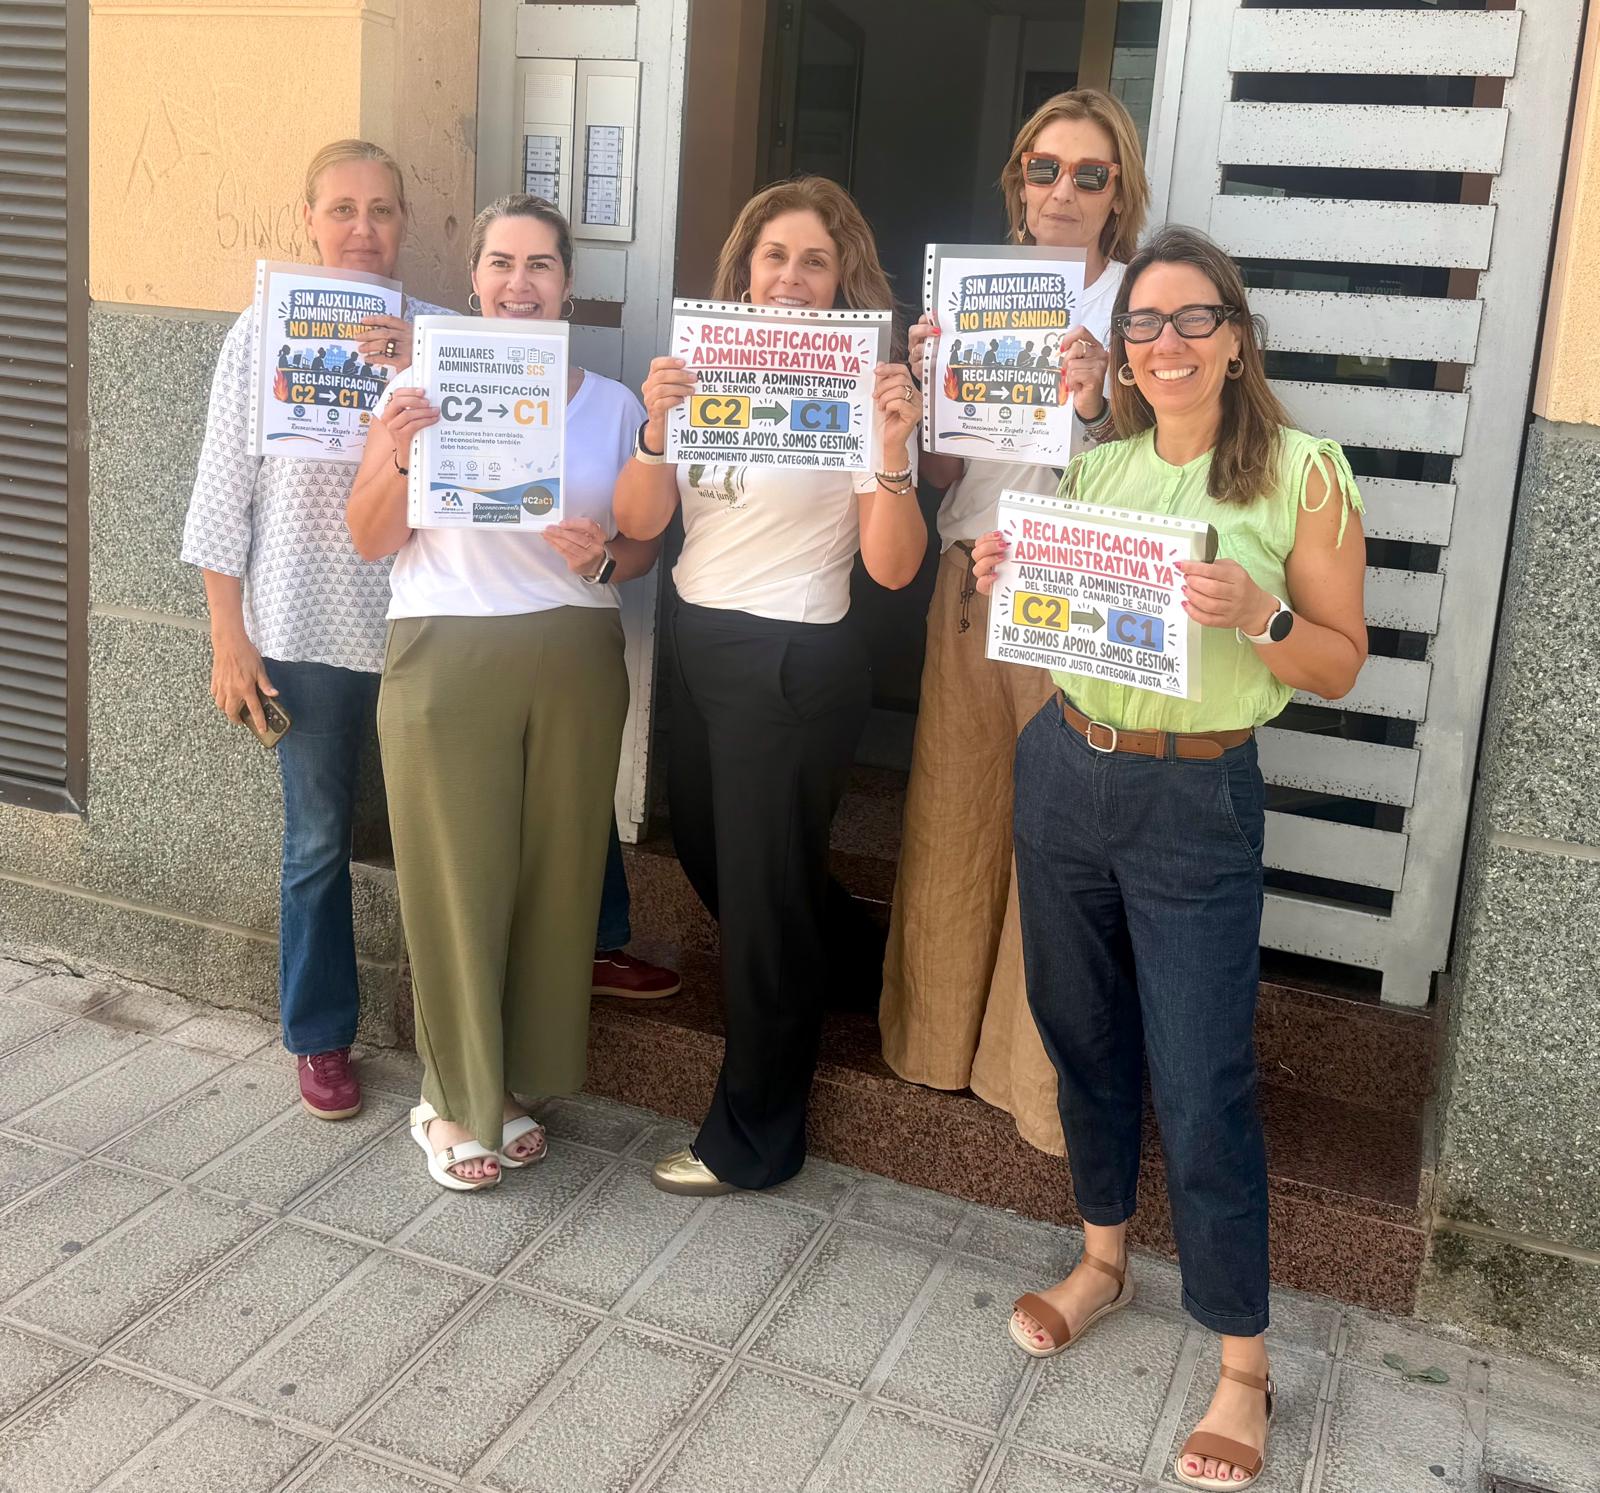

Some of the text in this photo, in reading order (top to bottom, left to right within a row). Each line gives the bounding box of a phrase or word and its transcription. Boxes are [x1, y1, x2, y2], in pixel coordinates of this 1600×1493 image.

[965, 276, 1062, 295] SIN AUXILIARES
[294, 292, 384, 311] SIN AUXILIARES
[963, 293, 1064, 311] ADMINISTRATIVOS
[289, 321, 308, 337] NO
[312, 322, 335, 338] HAY
[960, 310, 1066, 330] NO HAY SANIDAD
[701, 324, 853, 353] RECLASIFICACIÓN
[438, 346, 495, 360] AUXILIARES
[691, 347, 861, 374] ADMINISTRATIVA YA
[438, 360, 545, 377] ADMINISTRATIVOS SCS
[962, 369, 1056, 386] RECLASIFICACIÓN
[292, 372, 378, 393] RECLASIFICACIÓN
[439, 382, 550, 397] RECLASIFICACIÓN
[696, 370, 857, 391] AUXILIAR ADMINISTRATIVO
[291, 384, 381, 408] C2 C1 YA
[701, 384, 849, 399] DEL SERVICIO CANARIO DE SALUD
[961, 382, 1057, 404] C2 C1 YA
[440, 395, 549, 426] C2 C1
[699, 398, 842, 430] C2 C1
[680, 429, 859, 451] NO SOMOS APOYO, SOMOS GESTIÓN
[677, 450, 748, 463] RECONOCIMIENTO
[749, 452, 776, 464] JUSTO,
[777, 453, 820, 466] CATEGORÍA
[821, 455, 845, 467] JUSTA
[522, 496, 553, 505] #C2aC1
[1022, 518, 1164, 562] RECLASIFICACIÓN
[1014, 540, 1174, 587] ADMINISTRATIVA YA
[1018, 565, 1171, 606] AUXILIAR ADMINISTRATIVO
[1025, 580, 1163, 615] DEL SERVICIO CANARIO DE SALUD
[1022, 596, 1156, 649] C2 C1
[1002, 625, 1175, 673] NO SOMOS APOYO, SOMOS GESTIÓN
[998, 646, 1162, 689] RECONOCIMIENTO JUSTO, CATEGORÍA JUSTA
